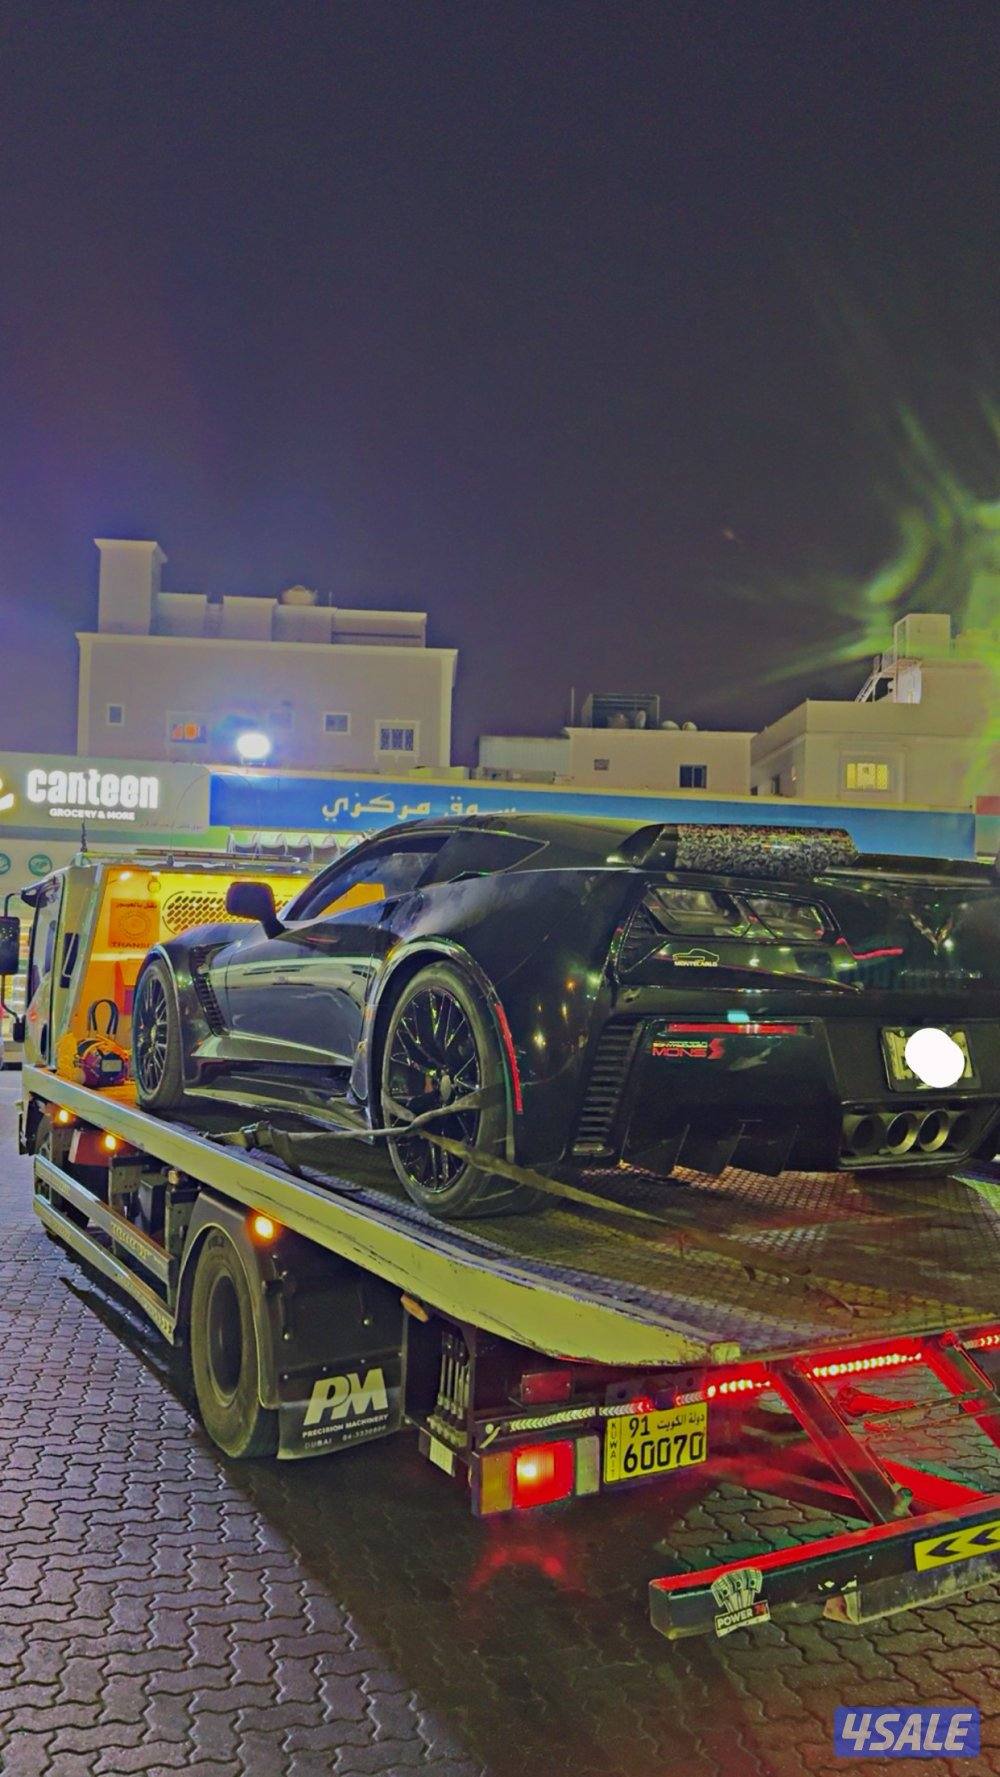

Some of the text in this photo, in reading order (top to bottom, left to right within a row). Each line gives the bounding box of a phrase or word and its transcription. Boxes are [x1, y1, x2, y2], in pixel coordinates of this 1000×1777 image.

[27, 769, 159, 809] canteen
[50, 808, 135, 821] GROCERY & MORE
[321, 793, 431, 823] مركزي
[303, 1368, 388, 1426] PM
[302, 1414, 389, 1438] PRECISION MACHINERY
[629, 1415, 650, 1438] 91
[657, 1414, 687, 1432] الكويت
[623, 1431, 704, 1473] 60070
[717, 1608, 754, 1629] POWER
